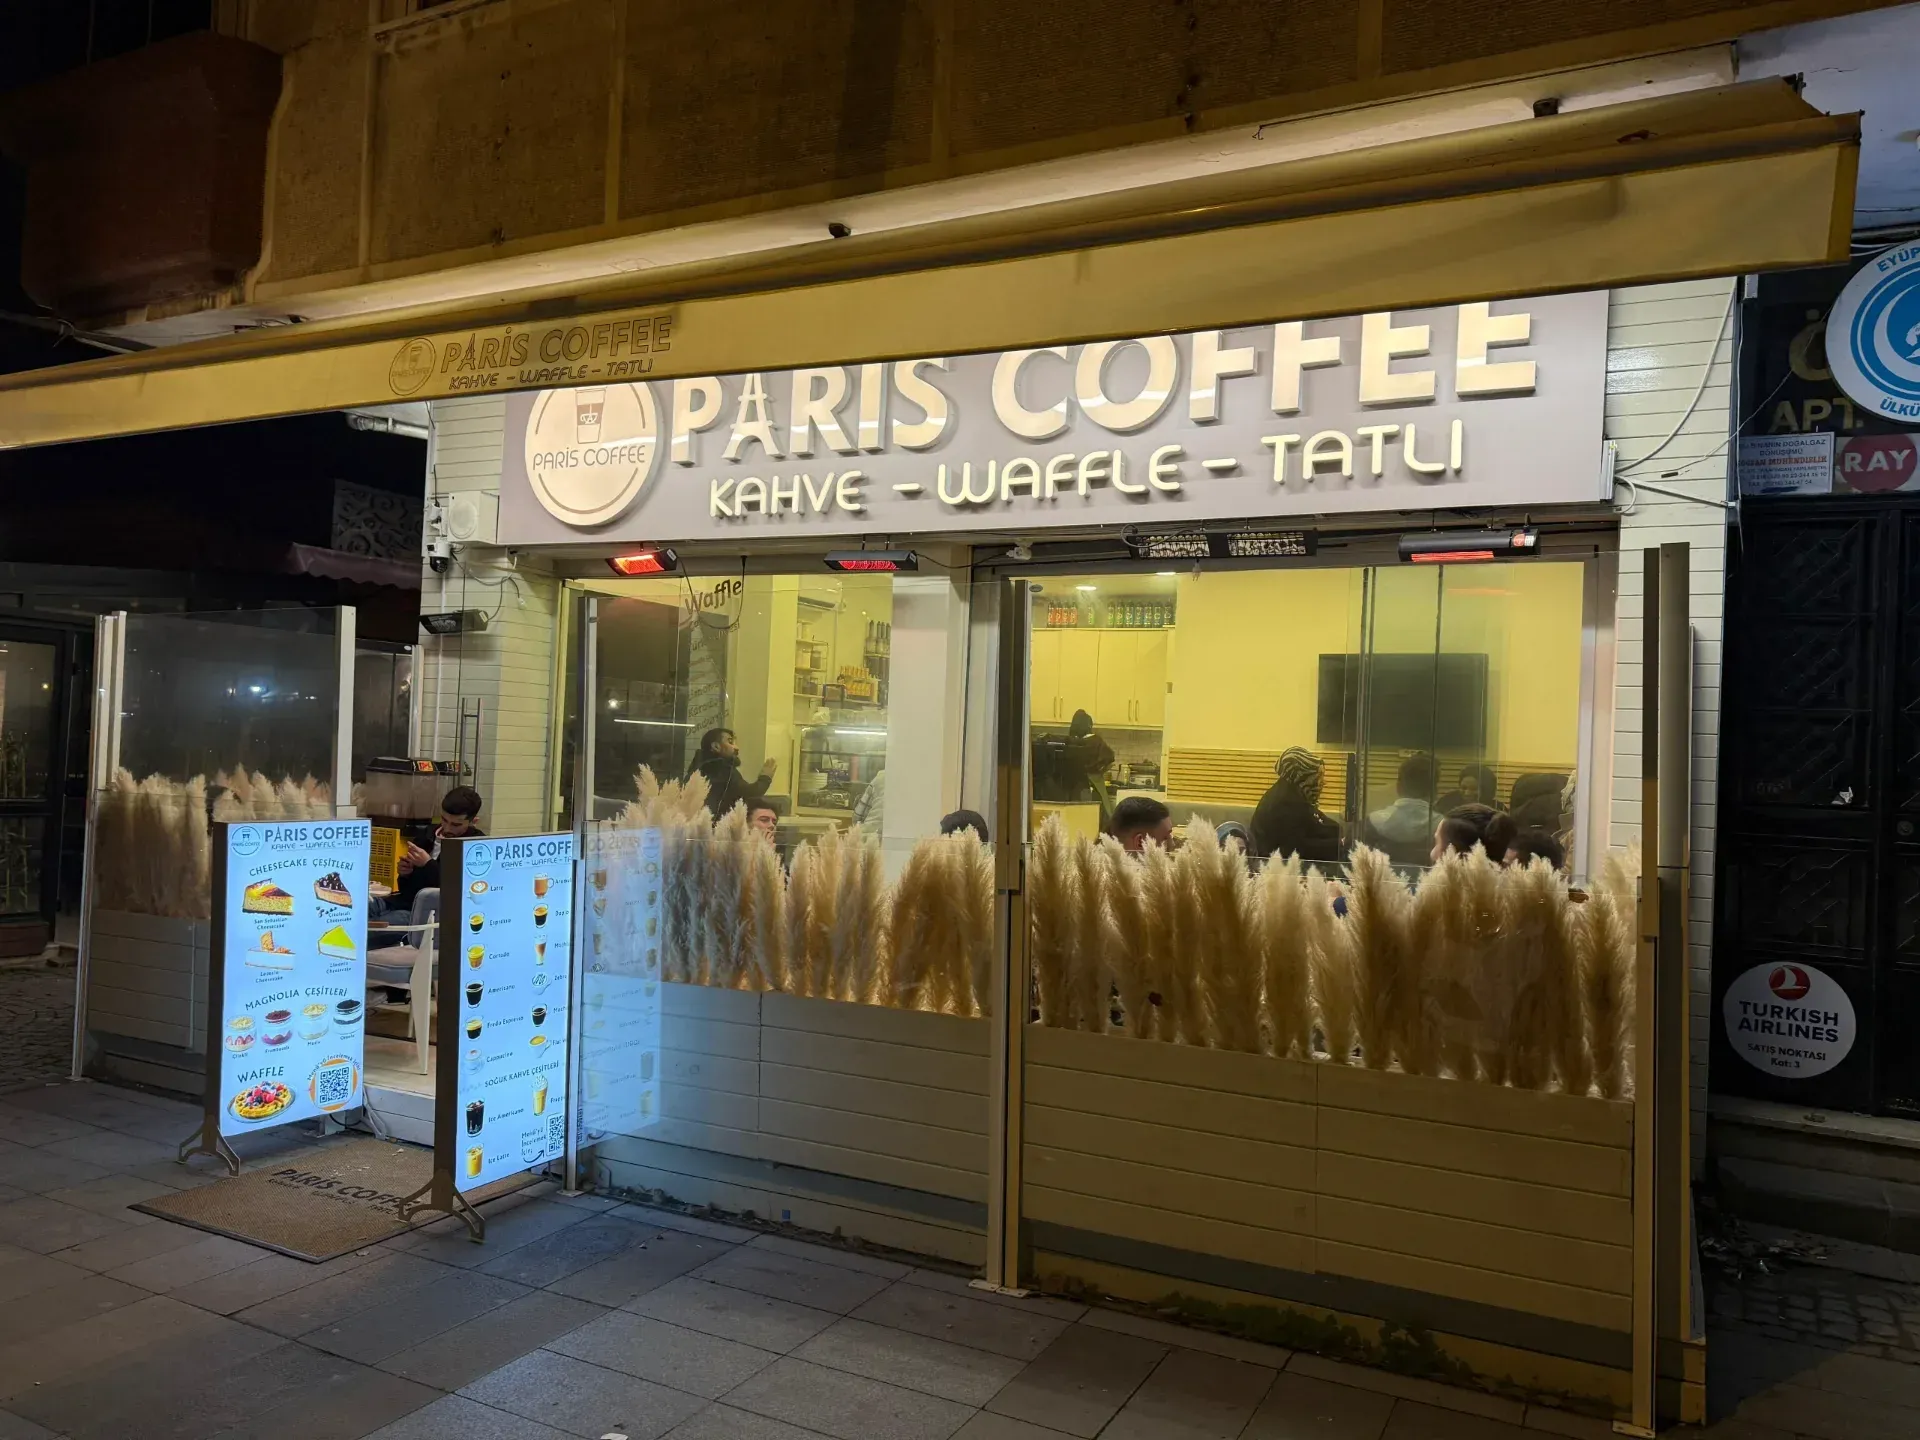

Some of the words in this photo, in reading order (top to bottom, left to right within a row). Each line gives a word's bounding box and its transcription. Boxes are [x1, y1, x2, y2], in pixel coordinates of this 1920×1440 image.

[539, 315, 672, 363] COFFEE
[449, 372, 500, 391] KAHVE
[519, 364, 589, 384] WAFFLE
[607, 358, 654, 376] TATLI
[991, 302, 1538, 441] COFFEE
[532, 447, 579, 471] PARİS
[583, 445, 646, 466] COFFEE
[709, 470, 869, 519] KAHVE
[937, 444, 1185, 507] WAFFLE
[1260, 419, 1464, 484] TATLI
[685, 579, 742, 615] Waffle
[271, 842, 296, 850] KAHVE
[312, 825, 369, 841] COFFEE
[249, 858, 308, 877] CHEESECAKE
[312, 857, 355, 871] ÇEŞİTLERİ
[501, 860, 523, 868] KAHVE
[245, 989, 300, 1011] MAGNOLIA
[304, 985, 348, 997] ÇEŞİTLERİ
[1738, 1000, 1839, 1027] TURKISH
[1738, 1017, 1839, 1043] AIRLINES
[1748, 1043, 1777, 1056] SATIŞ
[1778, 1046, 1827, 1061] NOKTASI
[237, 1066, 284, 1083] WAFFLE
[484, 1076, 508, 1088] SOĞUK
[509, 1069, 530, 1080] KAHVE
